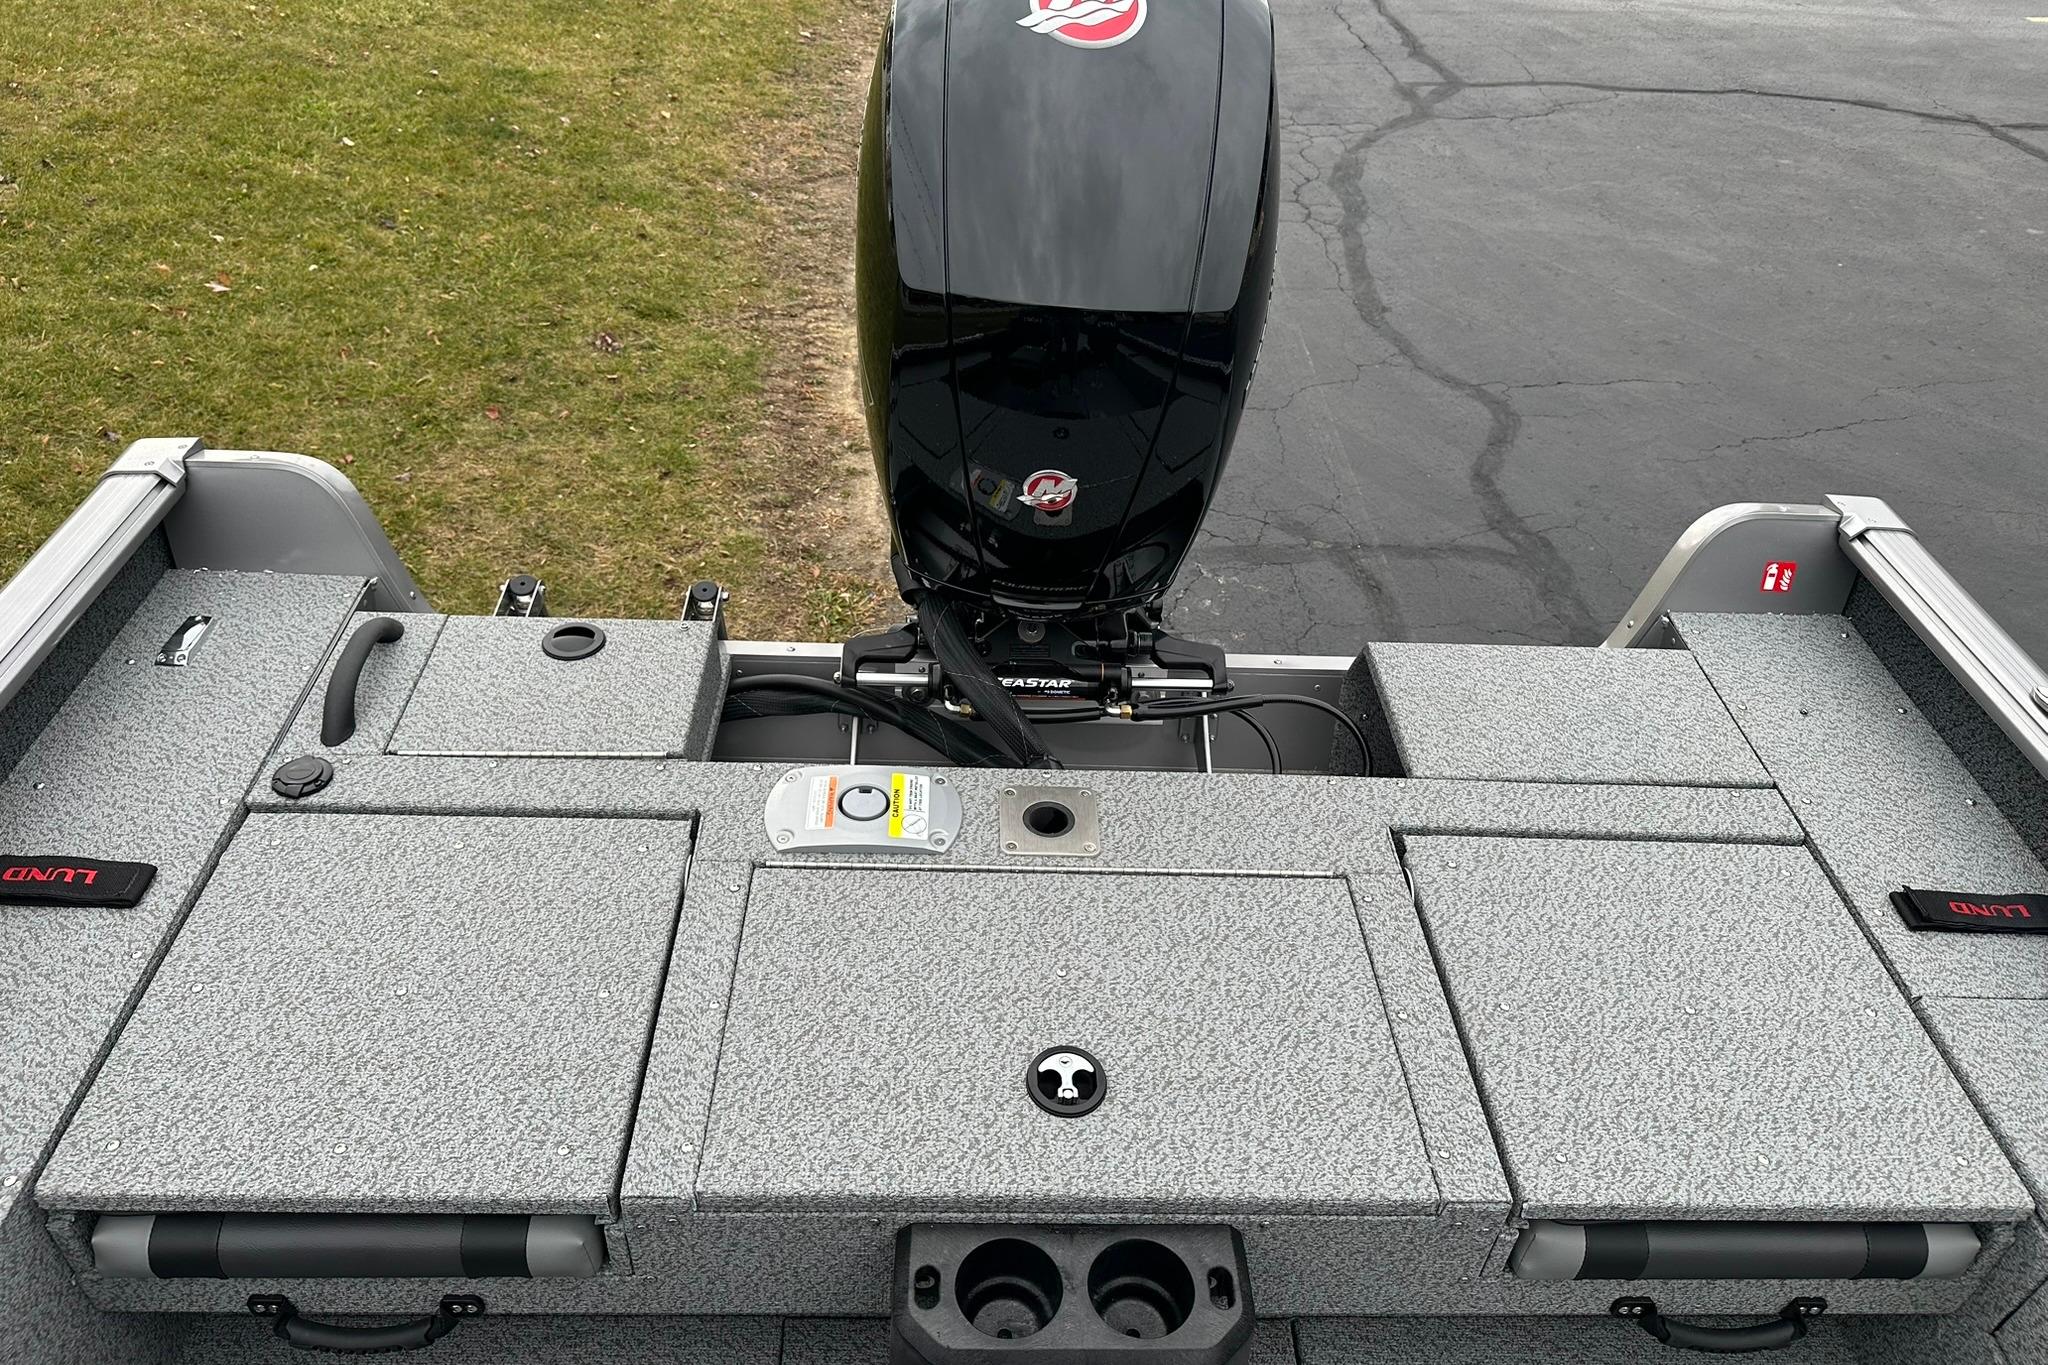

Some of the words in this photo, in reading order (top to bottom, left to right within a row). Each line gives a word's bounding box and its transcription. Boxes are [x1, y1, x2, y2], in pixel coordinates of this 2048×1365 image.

[997, 677, 1072, 688] EASTAR
[892, 788, 900, 818] CAUTION
[1, 866, 98, 885] LUND
[1949, 901, 2031, 918] LUND
